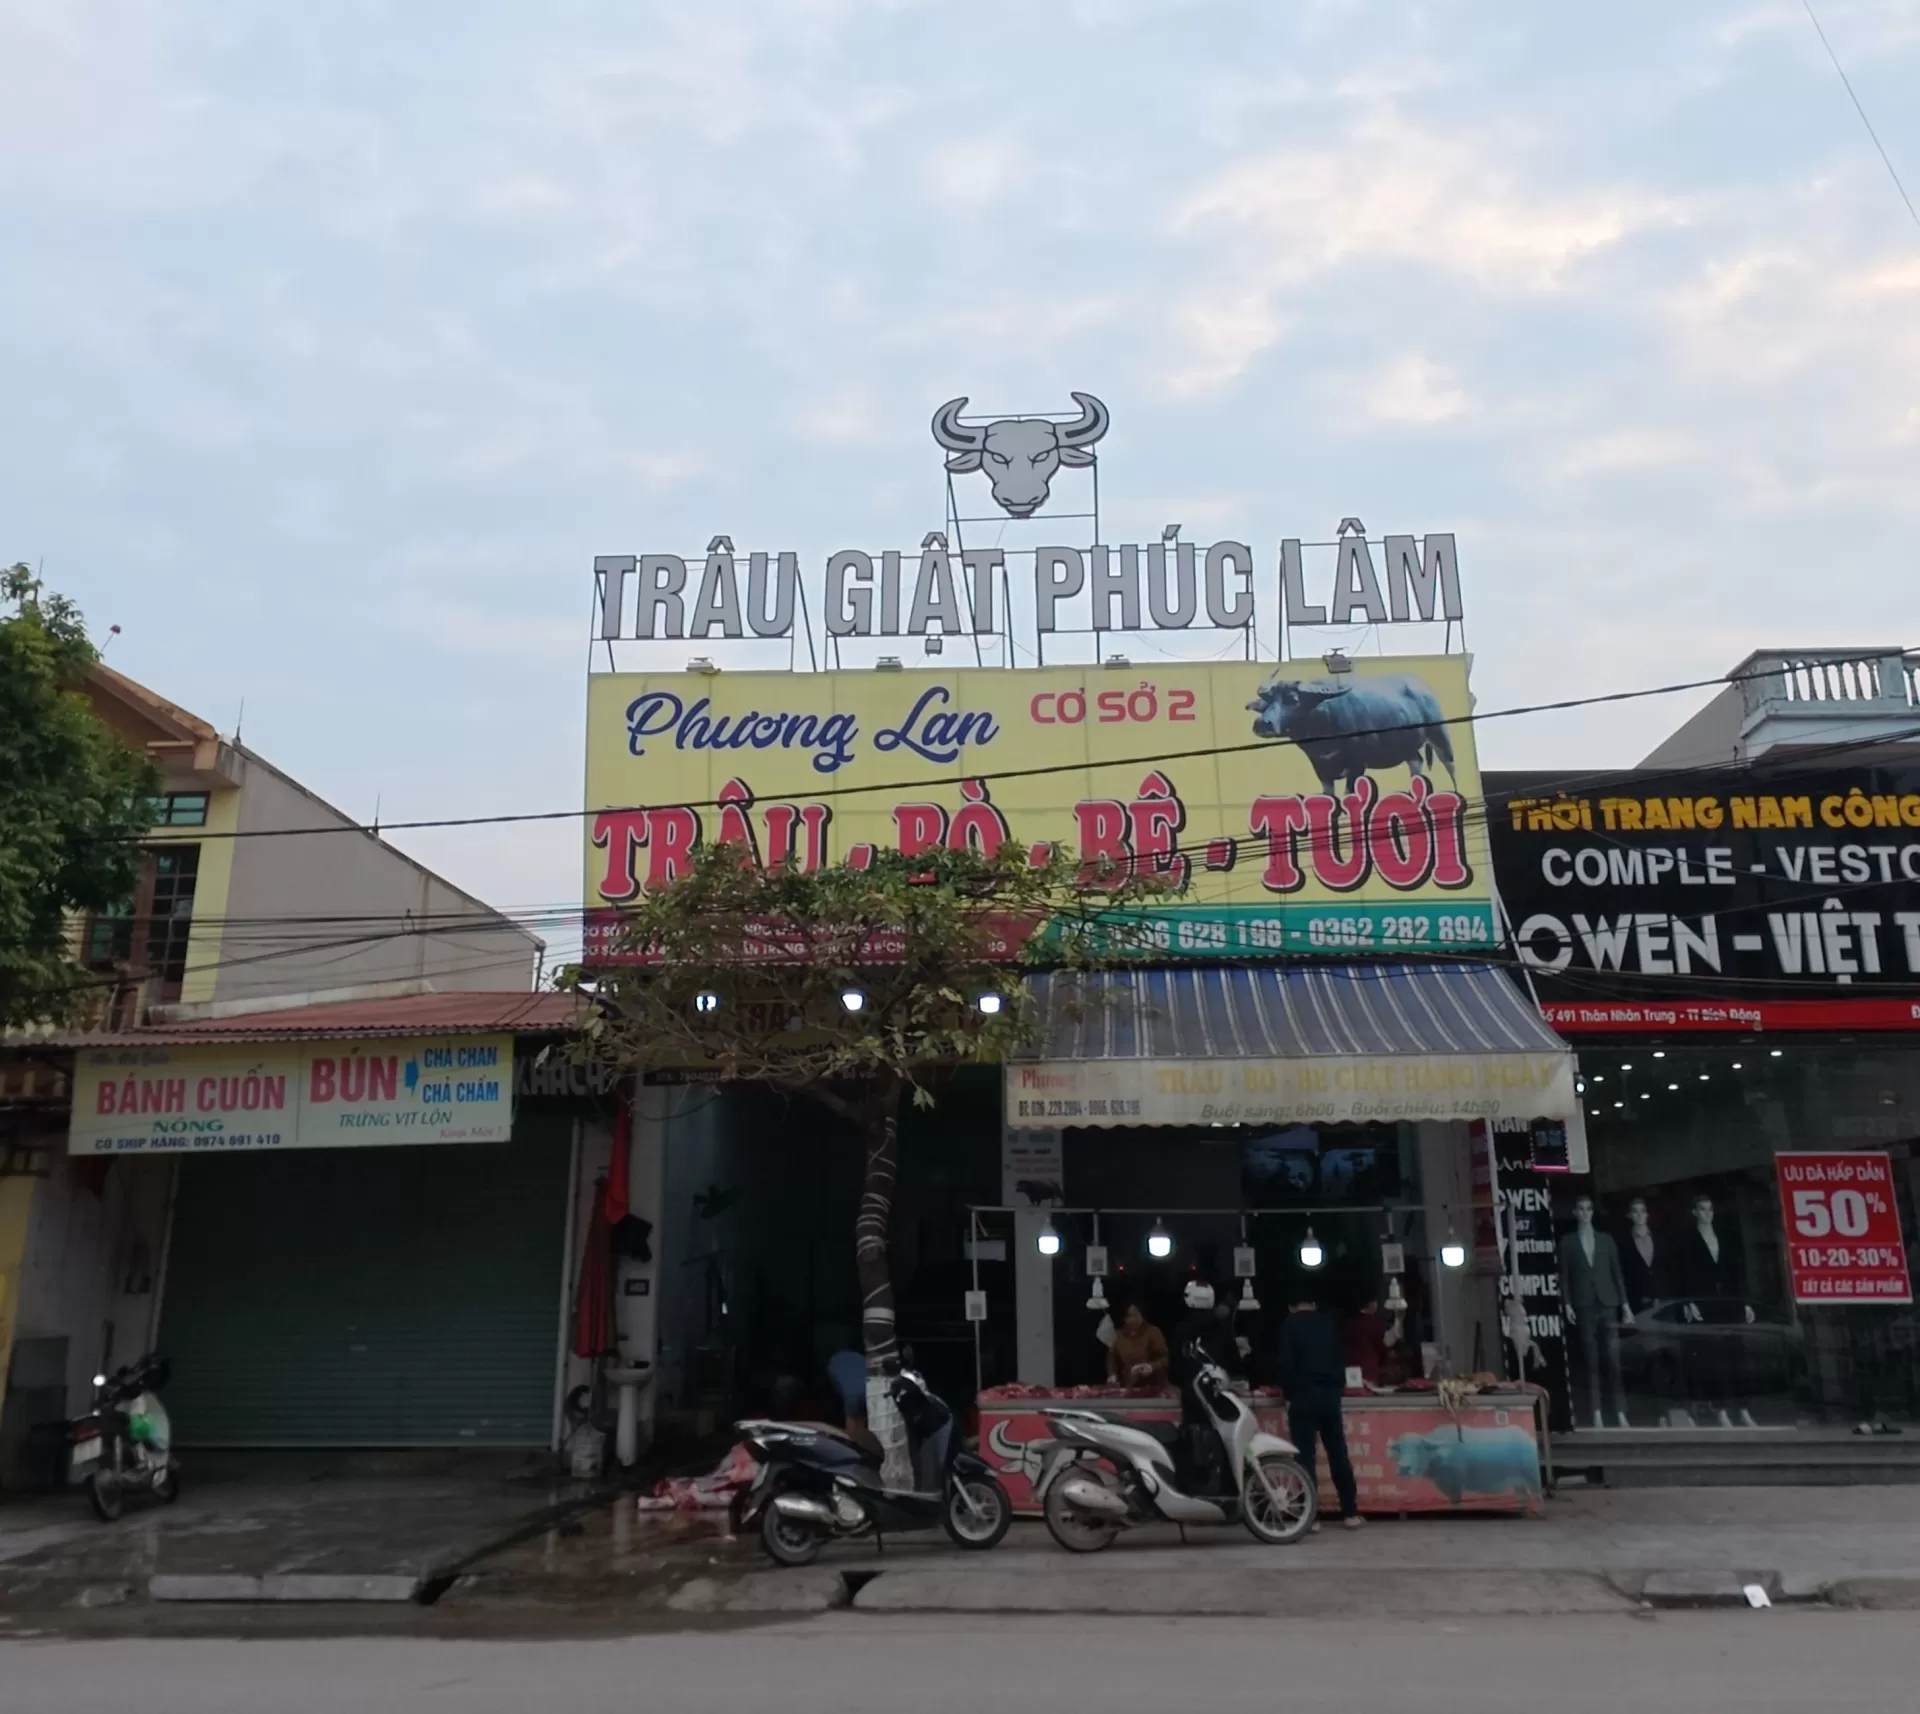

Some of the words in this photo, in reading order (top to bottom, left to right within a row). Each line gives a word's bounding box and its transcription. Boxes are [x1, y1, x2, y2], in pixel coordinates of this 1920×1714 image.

[594, 535, 798, 639] TRÂU
[824, 532, 1005, 655] GIẬT
[1036, 524, 1254, 631] PHÚC
[1281, 517, 1463, 624] LÂM
[1031, 687, 1086, 724] CƠ
[1097, 681, 1158, 722] SỞ
[1168, 690, 1195, 721] 2
[625, 691, 859, 773] Phương
[873, 686, 1000, 763] Lan
[1508, 790, 1593, 831] THỜI
[1599, 797, 1724, 830] TRANG
[1731, 796, 1814, 829] NAM
[1820, 785, 1920, 828] CÔNG
[1249, 775, 1474, 894] TƯƠI
[1541, 846, 1737, 887] COMPLE
[1178, 920, 1227, 949] 628
[1235, 919, 1282, 949] 198
[1308, 917, 1375, 946] 0362
[1382, 916, 1431, 945] 282
[1438, 915, 1489, 945] 894
[1517, 913, 1722, 976] OWEN
[1768, 898, 1881, 984] VIỆT
[1556, 1009, 1577, 1022] 491
[1643, 1009, 1677, 1024] Trung
[96, 1072, 186, 1115] BÁNH
[197, 1063, 286, 1112] CUỐN
[310, 1046, 398, 1103] BÚN
[1792, 1189, 1887, 1237] 50%
[1797, 1248, 1898, 1268] 10-20-30%
